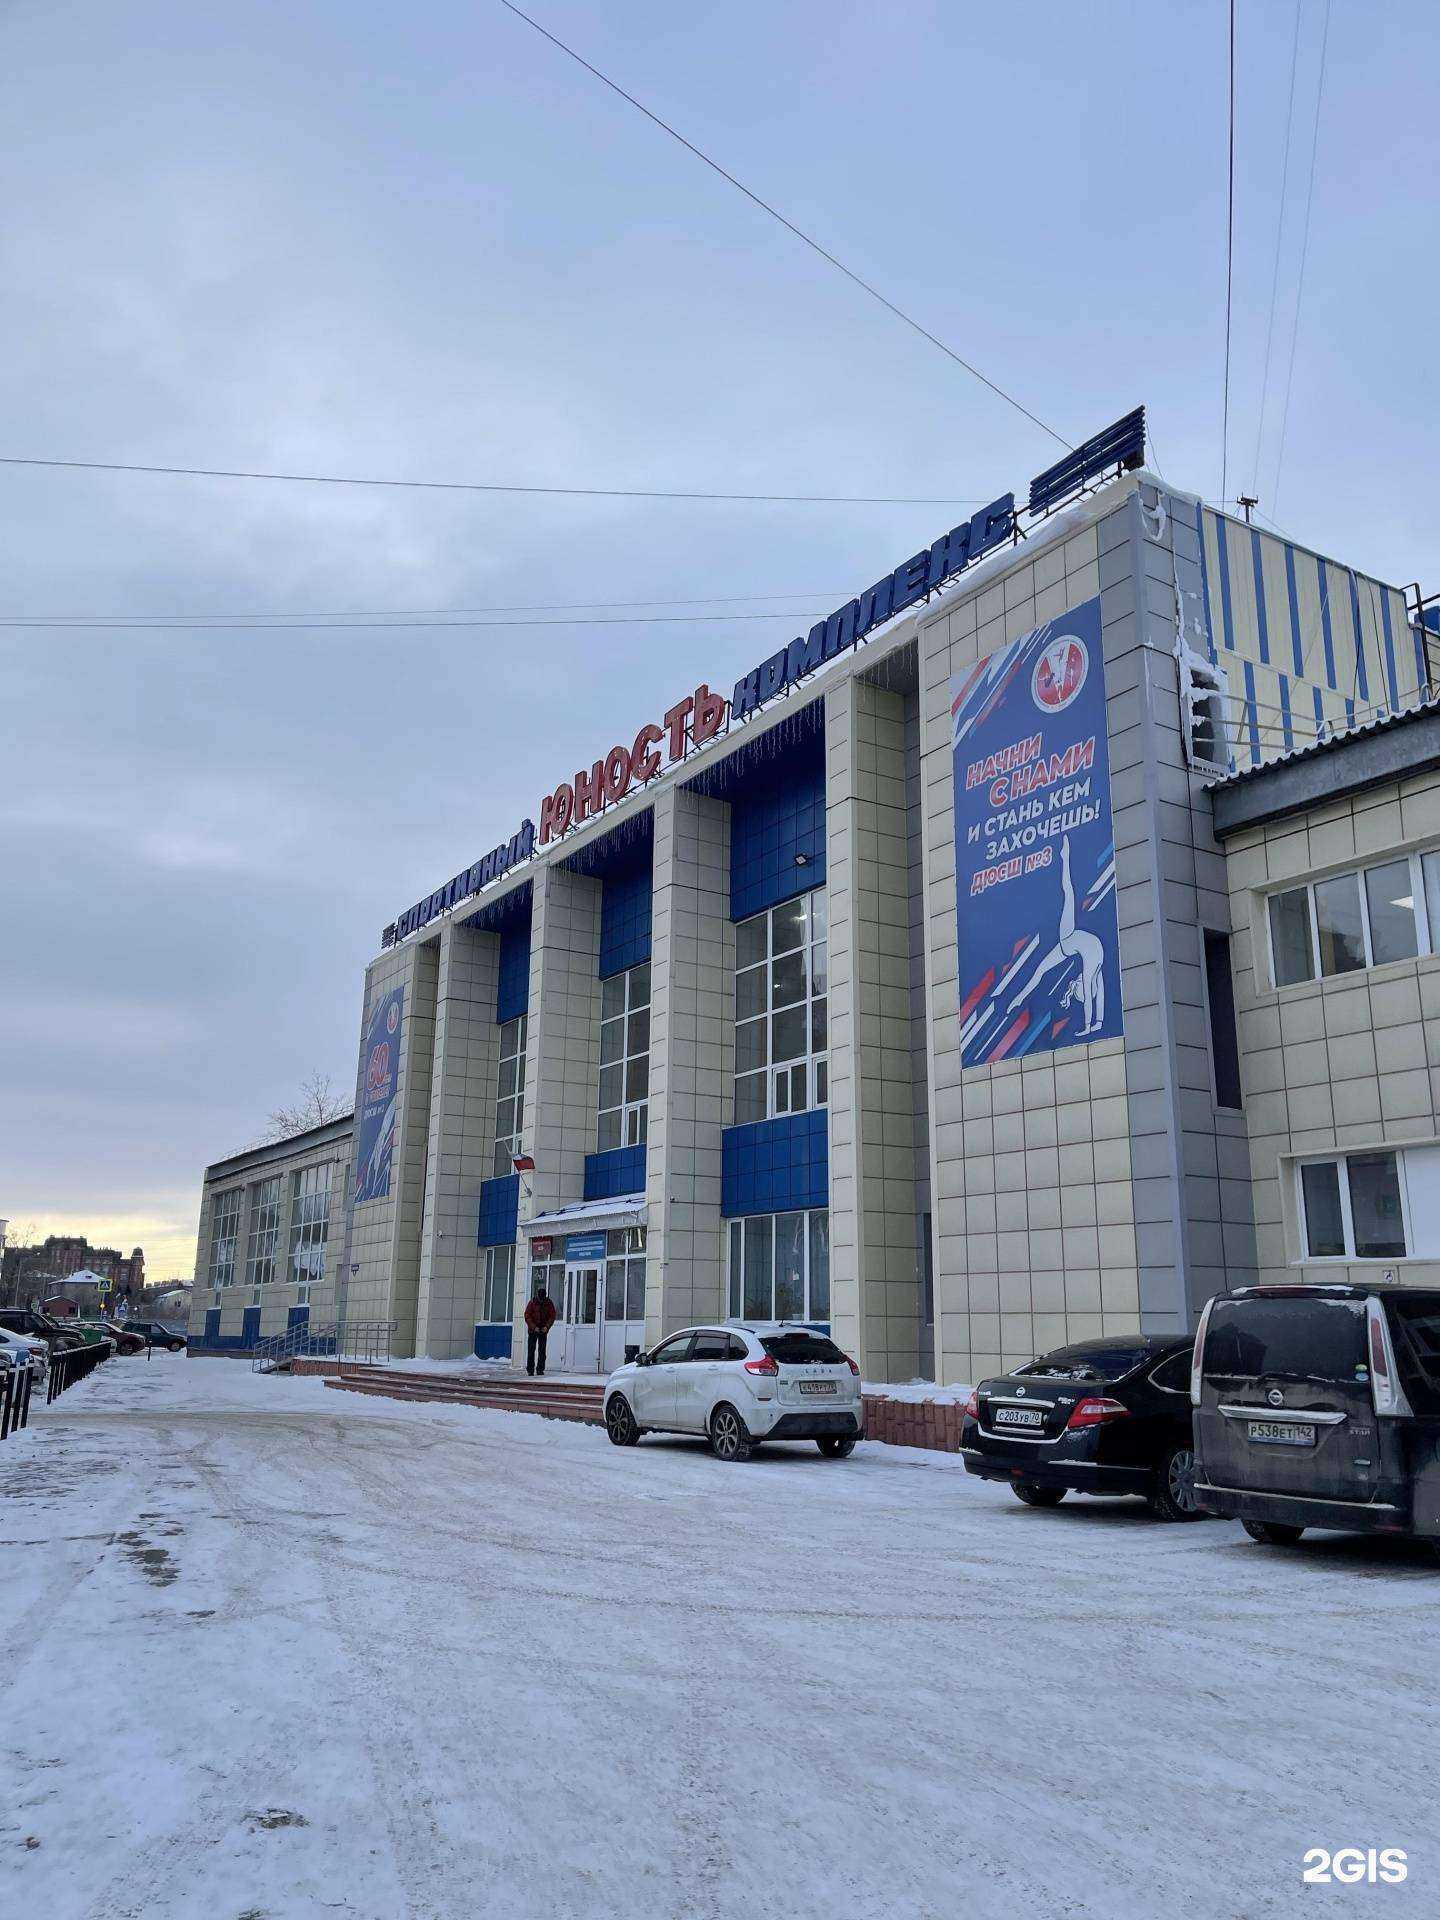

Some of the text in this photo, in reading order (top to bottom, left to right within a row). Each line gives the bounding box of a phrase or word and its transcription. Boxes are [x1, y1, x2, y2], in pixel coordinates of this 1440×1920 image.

[396, 492, 1015, 941] СПОРТИВНЫЙ ЮНОСТЬ КОМПЛЕКС
[966, 732, 1042, 790] НАЧНИ
[990, 736, 1095, 807] С НАМИ
[968, 777, 1091, 844] И СТАНЬ КЕМ
[986, 798, 1101, 860] ЗАХОЧЕШЬ!
[970, 856, 1023, 896] ДЮСШ
[1250, 1425, 1293, 1438] Р538ЕТ
